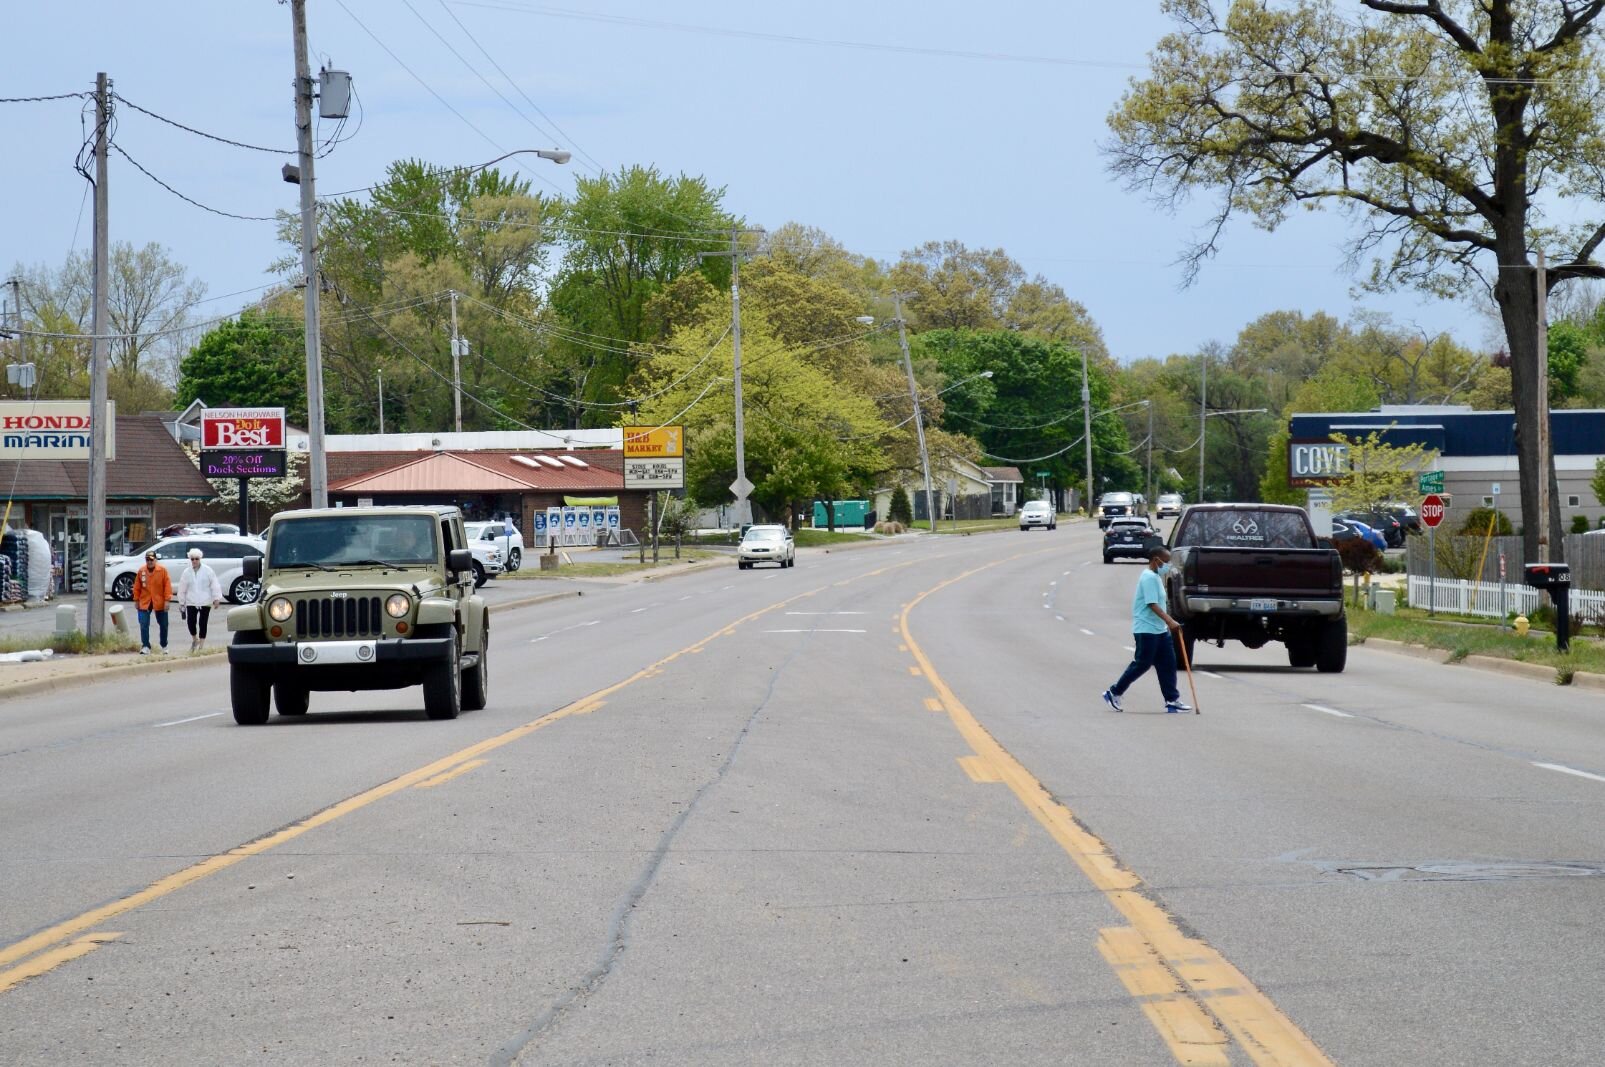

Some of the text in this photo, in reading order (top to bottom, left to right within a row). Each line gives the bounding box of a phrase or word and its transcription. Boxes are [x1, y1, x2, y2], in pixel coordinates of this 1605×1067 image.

[235, 419, 261, 430] Do it
[215, 423, 270, 446] Best
[4, 435, 91, 448] MARIN
[627, 444, 663, 453] MARKET
[222, 455, 263, 465] 20% Off
[1296, 446, 1346, 475] COVE
[208, 464, 277, 474] Dock Sections
[1423, 504, 1443, 518] STOP
